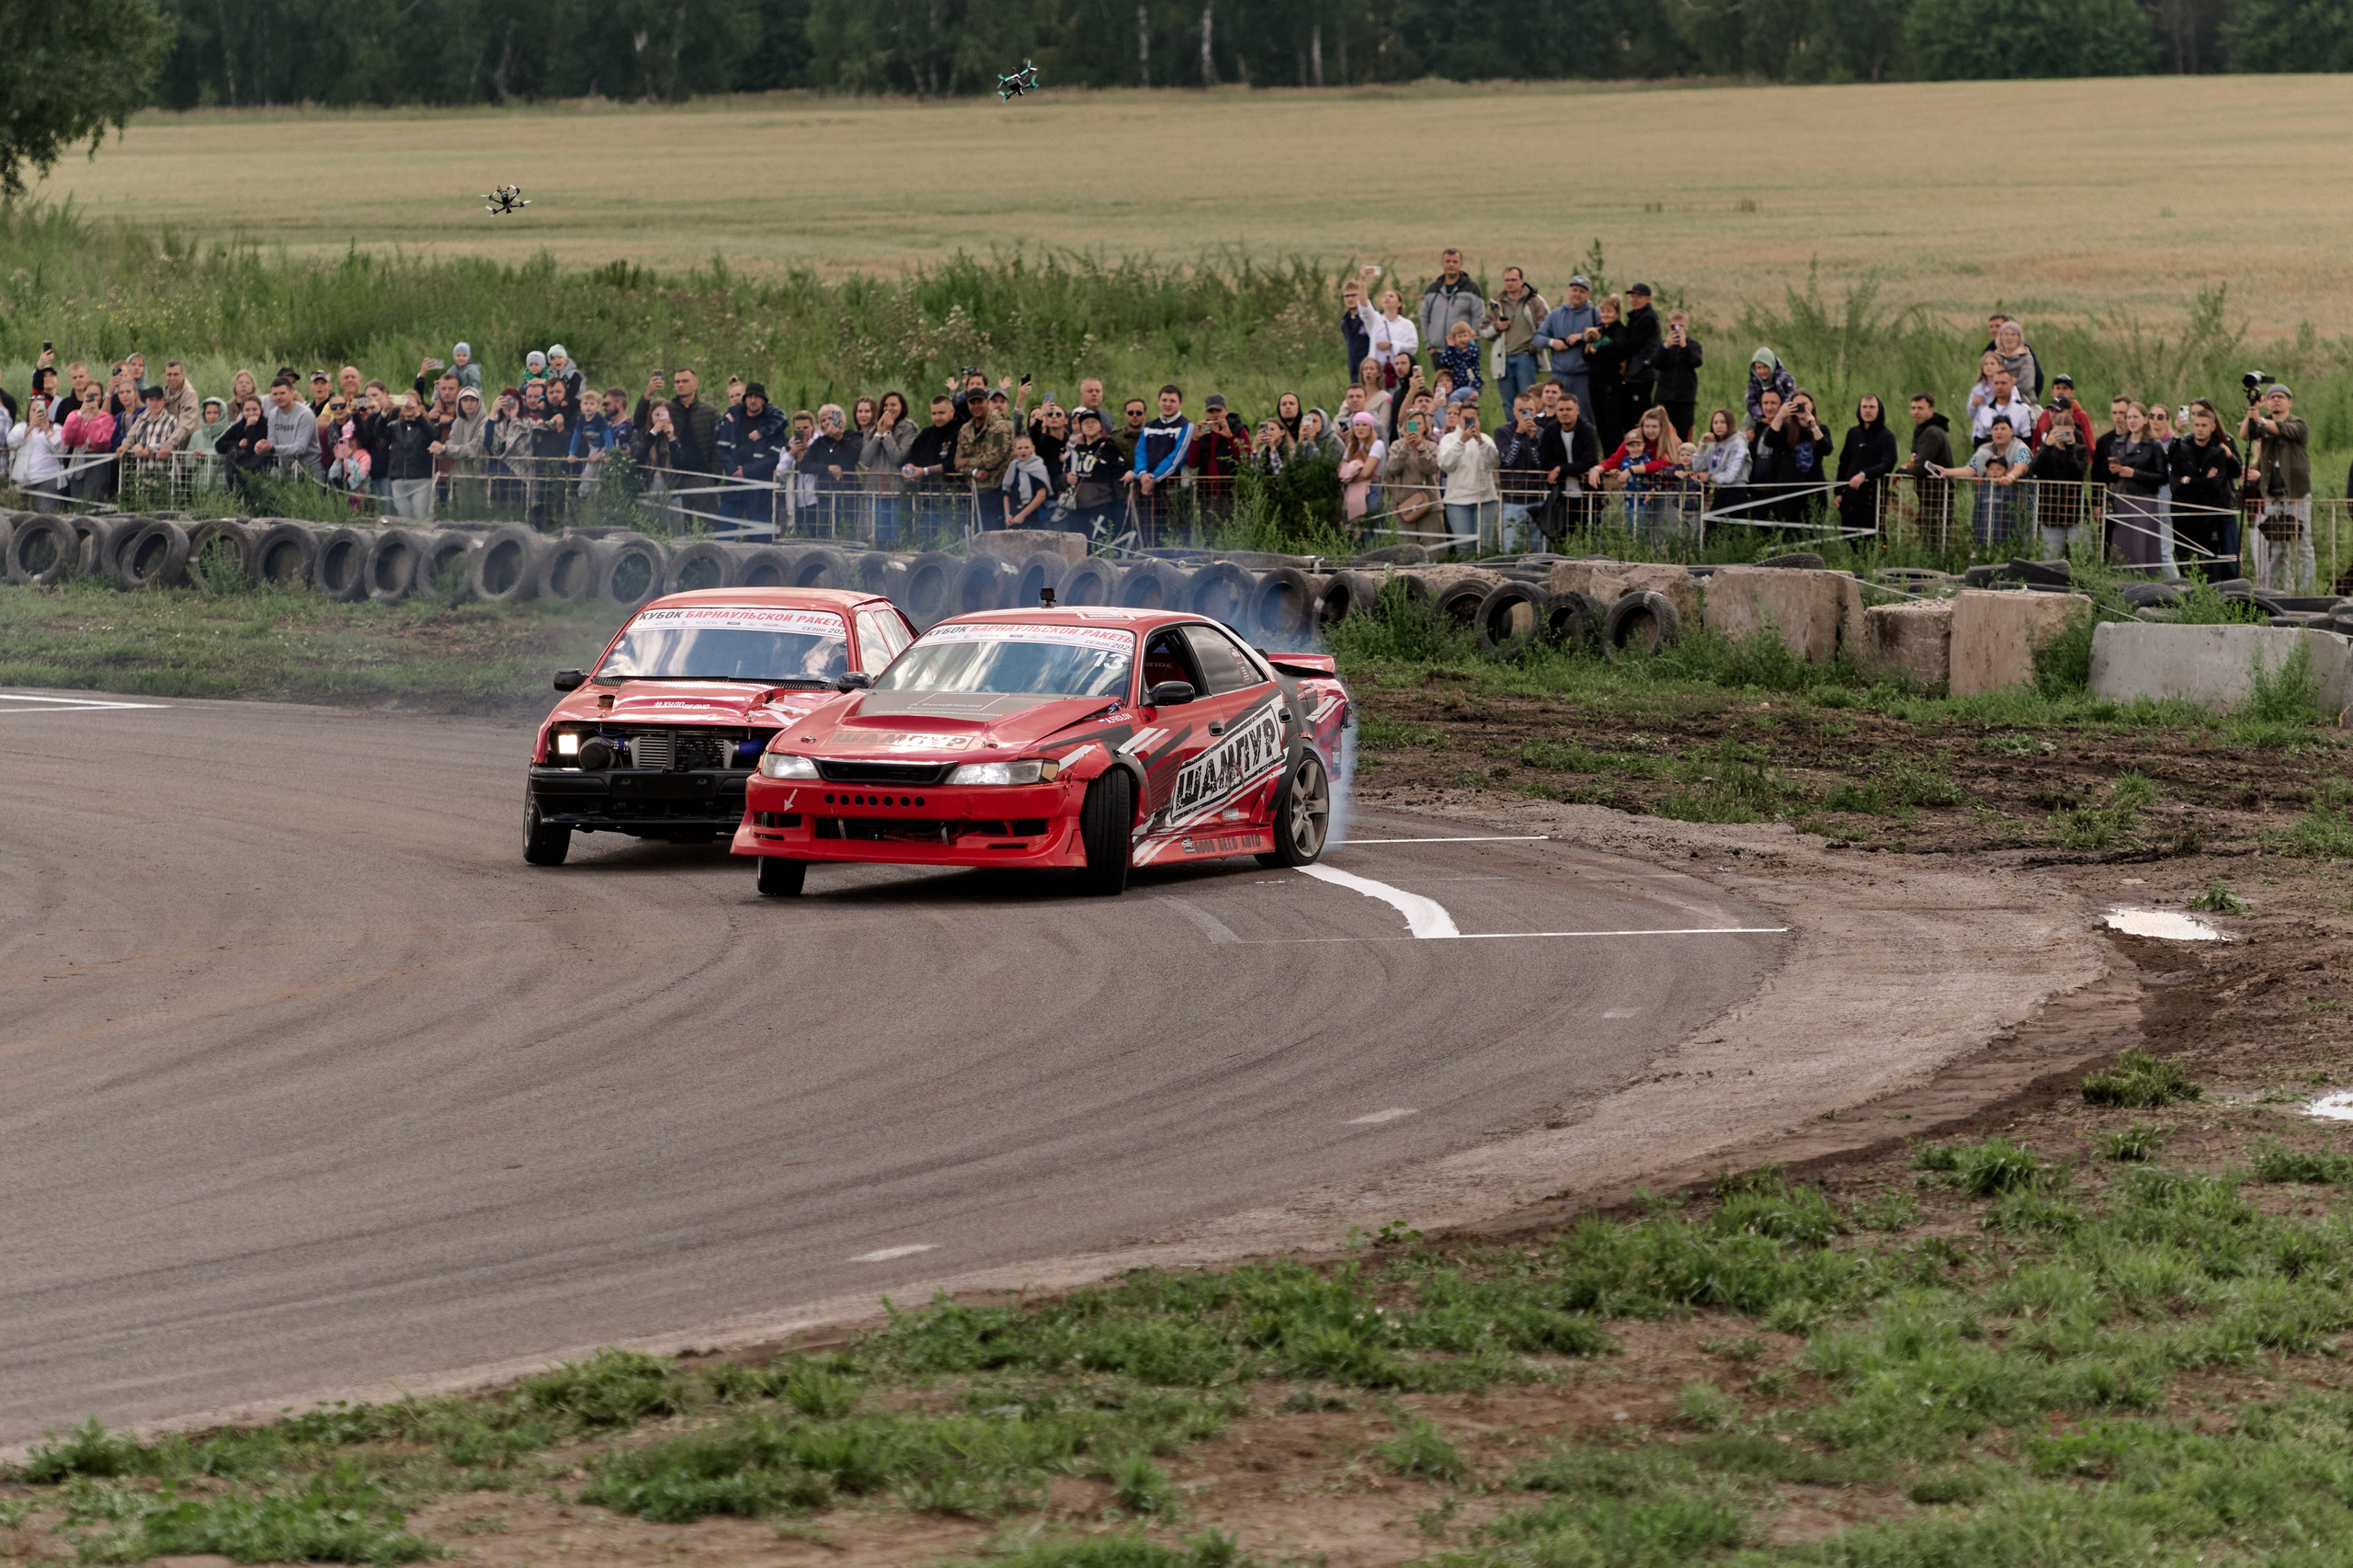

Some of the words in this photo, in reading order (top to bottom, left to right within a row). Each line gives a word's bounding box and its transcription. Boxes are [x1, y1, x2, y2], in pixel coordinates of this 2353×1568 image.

[639, 611, 684, 620] КУБОК
[685, 610, 794, 622] БАРНАУЛЬСКОЙ
[926, 626, 971, 638] КУБОК
[970, 625, 1080, 635] БАРНАУЛЬСКОЙ
[1094, 651, 1128, 670] 13
[832, 733, 967, 747] ШАМПР
[1176, 718, 1276, 811] ШАМПУР
[1195, 839, 1216, 854] GOOD
[1241, 835, 1261, 848] AUTO
